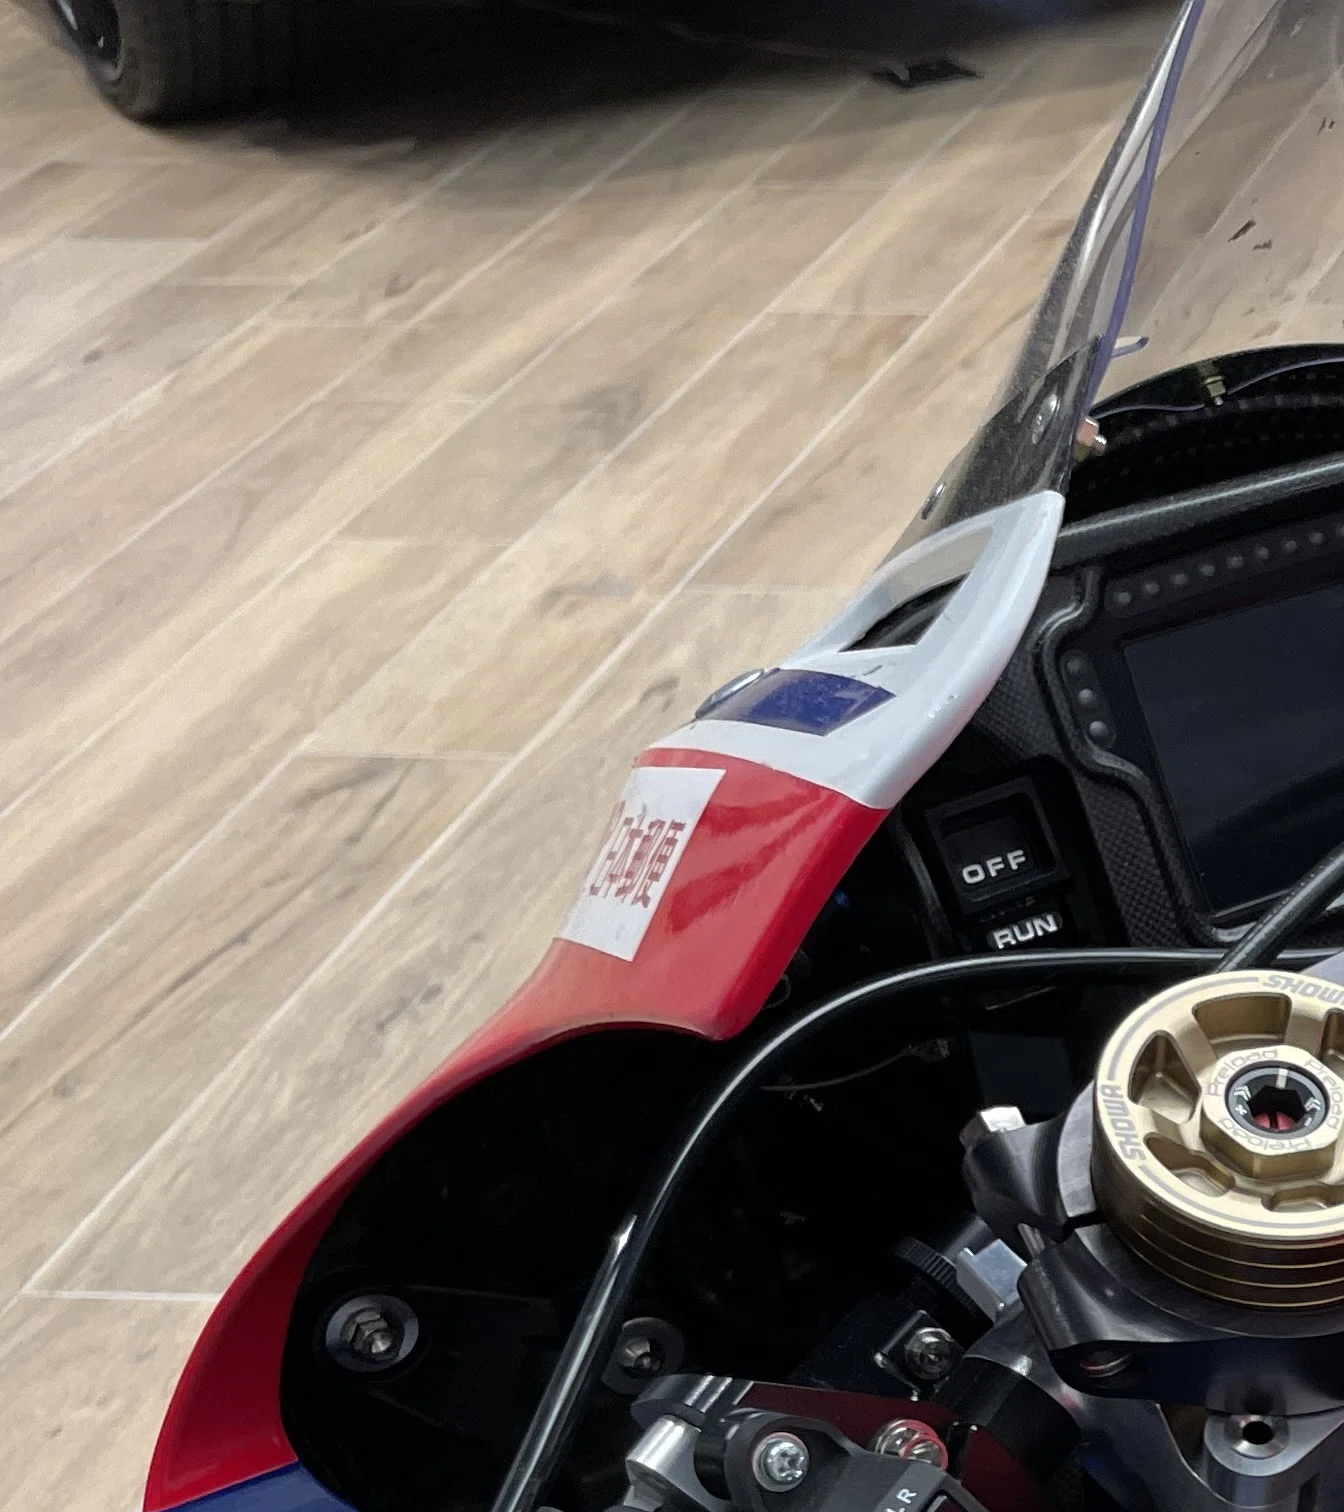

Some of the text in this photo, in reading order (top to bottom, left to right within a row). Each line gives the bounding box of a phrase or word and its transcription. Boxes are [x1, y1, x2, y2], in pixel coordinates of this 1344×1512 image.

[589, 803, 687, 908] 日本郵便
[961, 849, 1026, 884] OFF
[992, 914, 1058, 949] RUN
[1207, 1049, 1279, 1097] Preload
[1303, 1058, 1343, 1129] Preload
[1101, 1083, 1147, 1161] SHOWA
[1218, 1117, 1311, 1150] Preload
[899, 1487, 917, 1504] R
